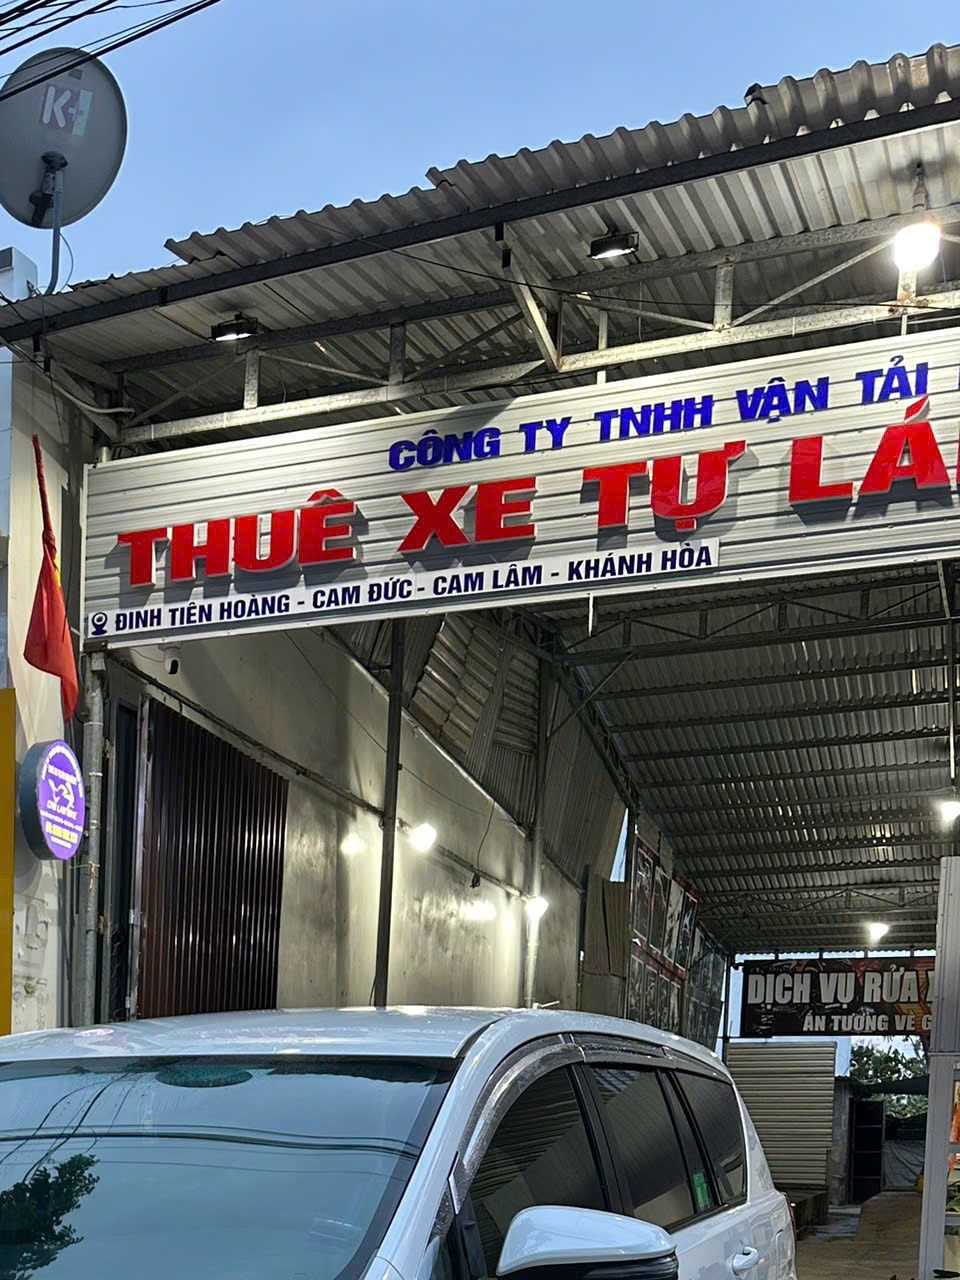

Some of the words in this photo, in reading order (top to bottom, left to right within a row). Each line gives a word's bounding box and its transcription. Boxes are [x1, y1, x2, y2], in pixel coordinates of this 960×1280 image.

[387, 426, 501, 472] CÔNG
[519, 416, 573, 455] TY
[594, 394, 715, 443] TNHH
[736, 376, 830, 424] VẬN
[856, 354, 930, 406] TẢI
[117, 487, 358, 587] THUÊ
[396, 474, 537, 554] XE
[582, 439, 747, 532] TỰ
[788, 393, 960, 504] LÁ
[115, 608, 162, 631] ĐINH
[168, 602, 212, 626] TIÊN
[219, 594, 290, 621] HOÀNG
[312, 585, 361, 609] CAM
[367, 577, 413, 602] ĐỨC
[433, 571, 485, 596] CAM
[492, 563, 542, 589] LÂM
[567, 550, 653, 582] KHÁNH
[660, 542, 712, 571] HÒA
[747, 972, 812, 1010] DỊCH
[818, 971, 856, 1010] VỤ
[863, 964, 920, 1003] RỬA
[831, 1013, 890, 1034] TƯỢNG
